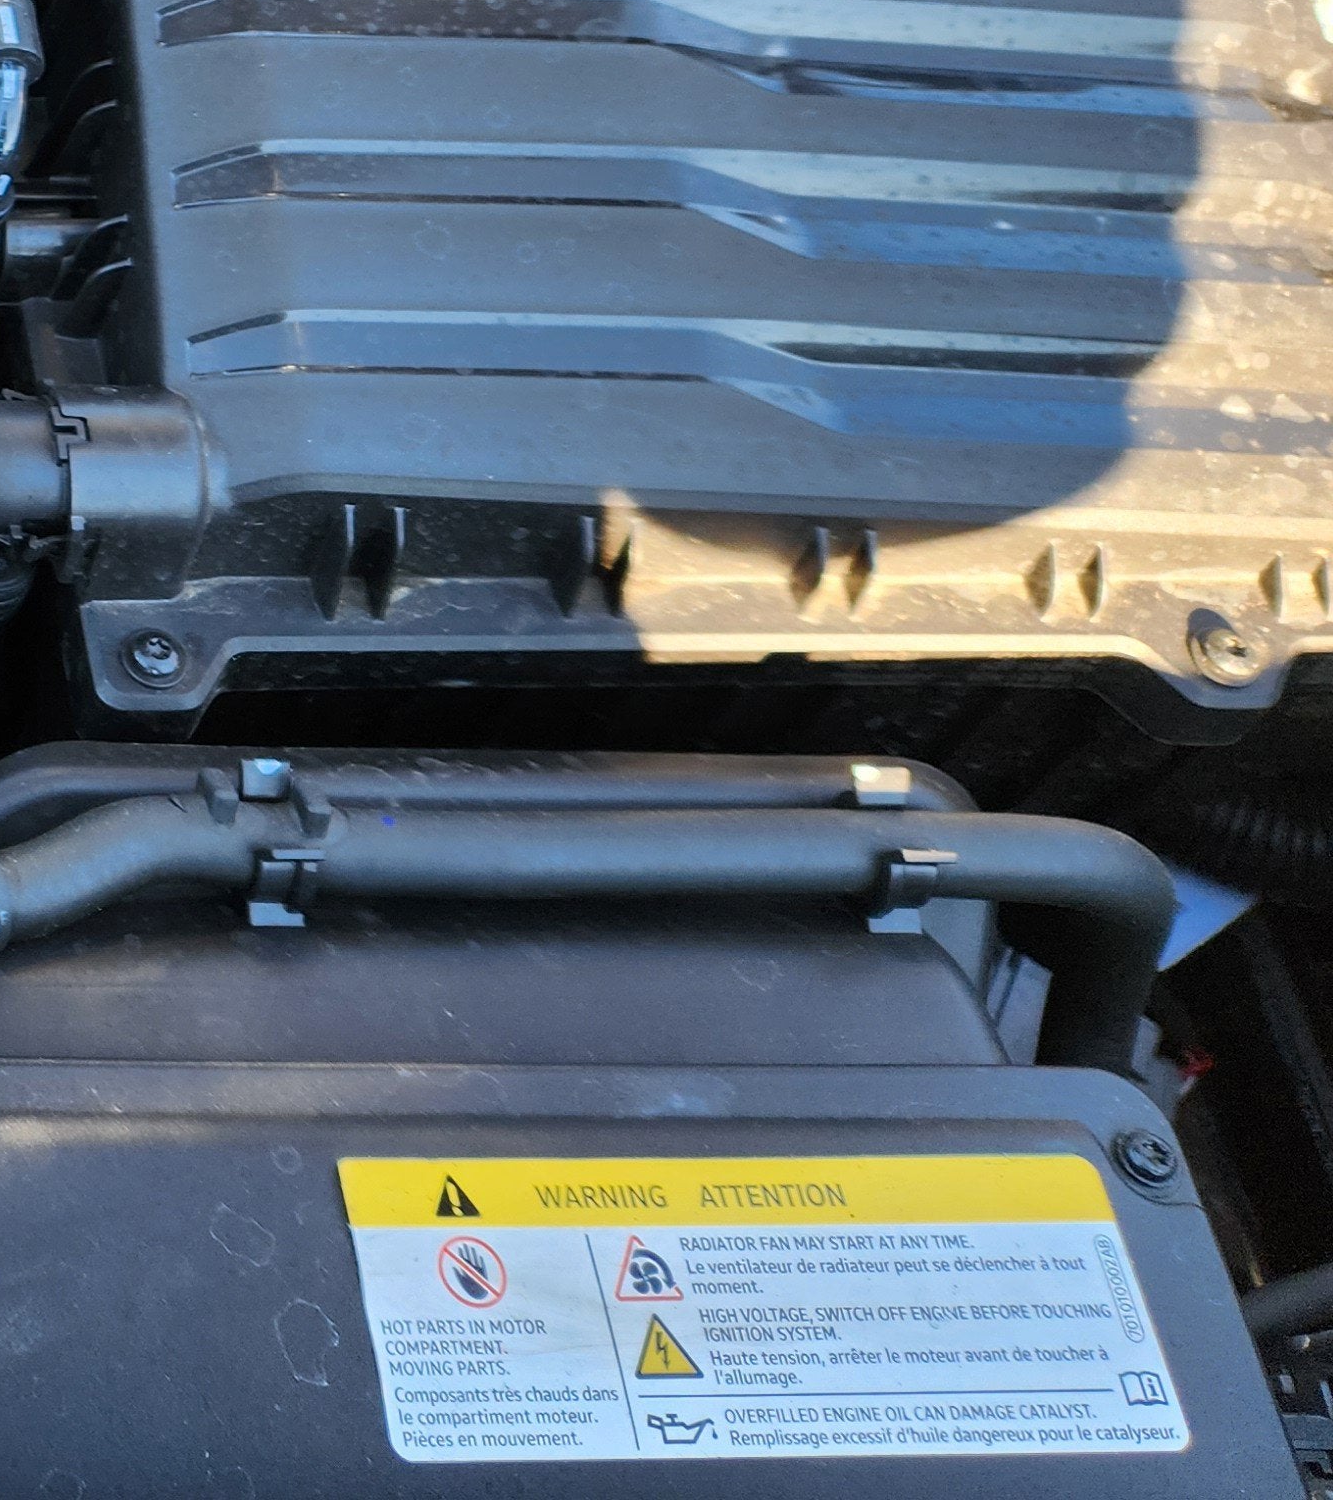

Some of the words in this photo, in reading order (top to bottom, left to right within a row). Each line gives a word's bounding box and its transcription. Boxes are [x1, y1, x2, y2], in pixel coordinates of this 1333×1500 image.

[534, 1184, 669, 1209] WARNING
[700, 1184, 848, 1208] ATTENTION
[679, 1236, 757, 1252] RADIATOR
[760, 1237, 791, 1251] FAN
[794, 1236, 826, 1250] MAY
[829, 1236, 877, 1250] START
[879, 1235, 899, 1249] AT
[900, 1235, 932, 1249] ANY
[932, 1234, 975, 1249] TIME.
[686, 1259, 706, 1275] Le
[708, 1259, 793, 1275] ventilateur
[797, 1258, 817, 1274] de
[820, 1258, 891, 1274] radiateur
[895, 1258, 930, 1276] peut
[932, 1260, 951, 1273] se
[954, 1256, 1037, 1273] déclencher
[1040, 1255, 1052, 1271] à
[1054, 1256, 1087, 1271] tout
[692, 1280, 764, 1295] moment.
[699, 1308, 739, 1324] HIGH
[740, 1307, 814, 1325] VOLTAGE,
[816, 1306, 875, 1322] SWITCH
[878, 1306, 908, 1322] OFF
[971, 1304, 1031, 1320] BEFORE
[1031, 1303, 1112, 1320] TOUCHING
[380, 1320, 414, 1336] HOT
[416, 1320, 465, 1336] PARTS
[468, 1320, 486, 1335] IN
[487, 1319, 547, 1335] MOTOR
[703, 1327, 775, 1342] IGNITION
[777, 1326, 842, 1342] SYSTEM.
[385, 1340, 508, 1356] COMPARTMENT.
[709, 1351, 758, 1367] Haute
[761, 1351, 826, 1367] tension,
[829, 1349, 883, 1365] arrêter
[886, 1349, 901, 1363] le
[905, 1349, 962, 1364] moteur
[965, 1348, 1010, 1362] avant
[1013, 1346, 1032, 1361] de
[1035, 1345, 1095, 1361] toucher
[1099, 1344, 1110, 1360] à
[389, 1361, 455, 1377] MOVING
[457, 1361, 511, 1376] PARTS.
[715, 1370, 803, 1388] l'allumage.
[394, 1387, 491, 1407] Composants
[493, 1386, 523, 1402] très
[526, 1386, 580, 1402] chauds
[583, 1385, 619, 1401] dans
[399, 1409, 414, 1425] le
[417, 1409, 531, 1430] compartiment
[536, 1409, 599, 1424] moteur.
[724, 1409, 820, 1424] OVERFILLED
[823, 1408, 883, 1423] ENGINE
[885, 1407, 912, 1422] OIL
[914, 1406, 947, 1421] CAN
[950, 1405, 1016, 1421] DAMAGE
[1019, 1404, 1097, 1419] CATALYST.
[404, 1431, 454, 1448] Pièces
[458, 1435, 477, 1447] en
[482, 1431, 583, 1447] mouvement.
[729, 1430, 829, 1449] Remplissage
[832, 1429, 894, 1445] excessif
[897, 1428, 949, 1443] d'huile
[952, 1426, 1034, 1447] dangereux
[1039, 1428, 1075, 1444] pour
[1078, 1425, 1093, 1441] le
[1095, 1425, 1180, 1443] catalyseur.
